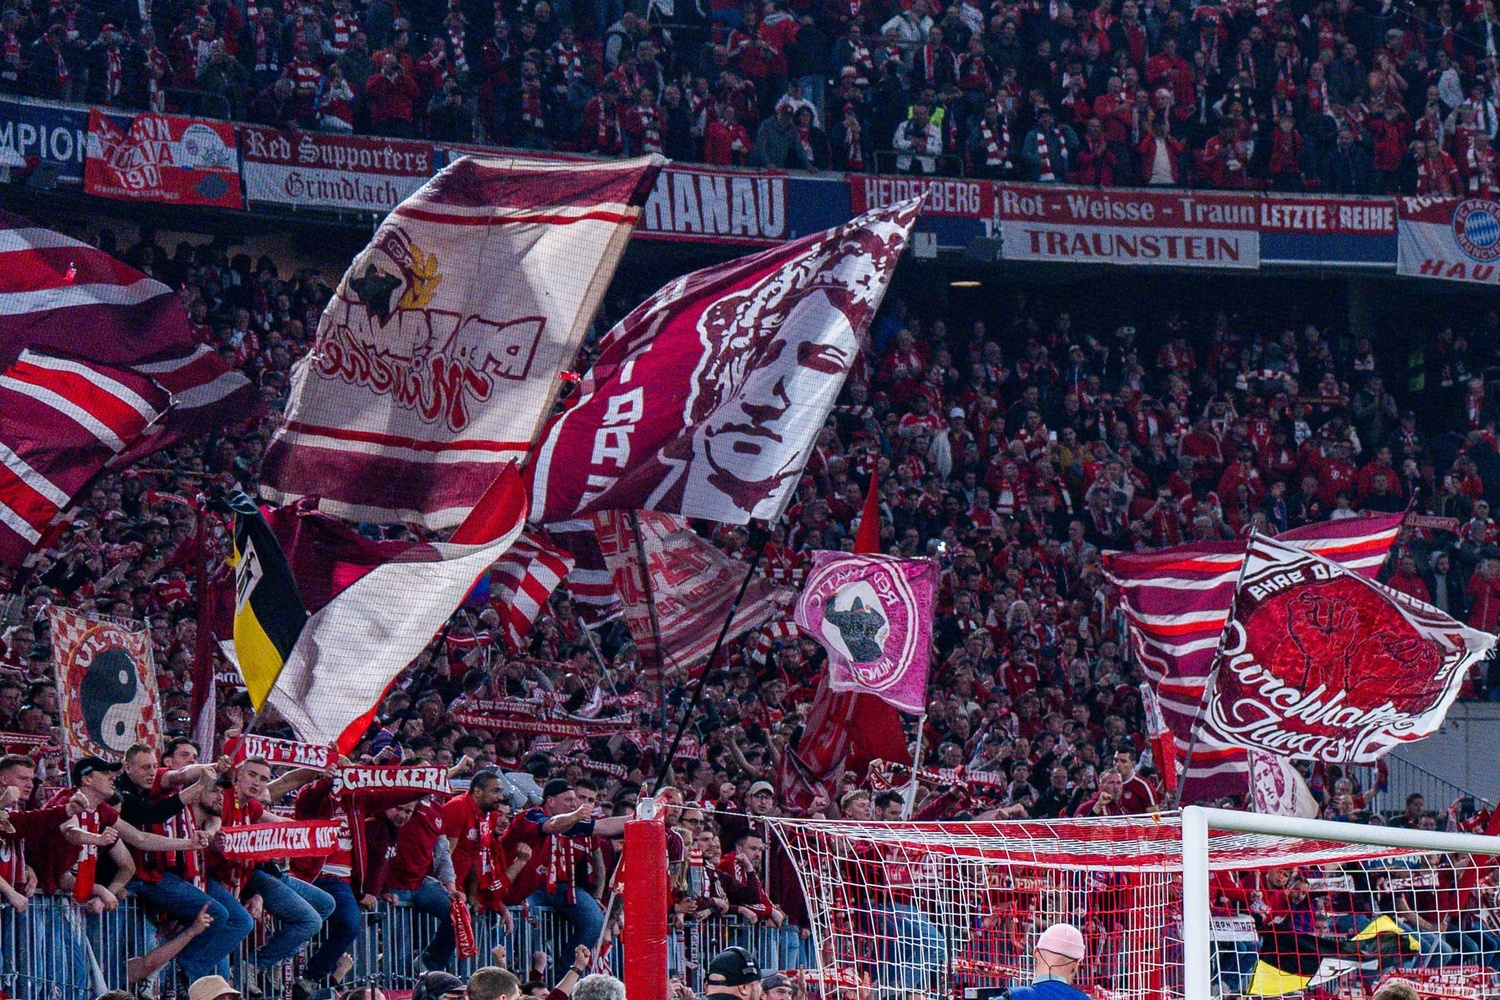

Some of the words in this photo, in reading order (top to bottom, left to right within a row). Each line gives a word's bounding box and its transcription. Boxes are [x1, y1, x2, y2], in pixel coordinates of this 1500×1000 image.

[247, 129, 291, 160] Red
[298, 136, 428, 172] Supporters
[646, 170, 786, 238] HANAU
[1003, 191, 1044, 215] Rot
[1067, 195, 1154, 222] Weisse
[1184, 198, 1256, 225] Traun
[1262, 207, 1326, 230] LETZTE
[1340, 206, 1392, 231] REIHE
[1024, 229, 1239, 261] TRAUNSTEIN
[224, 826, 310, 853] DURCHHALTEN
